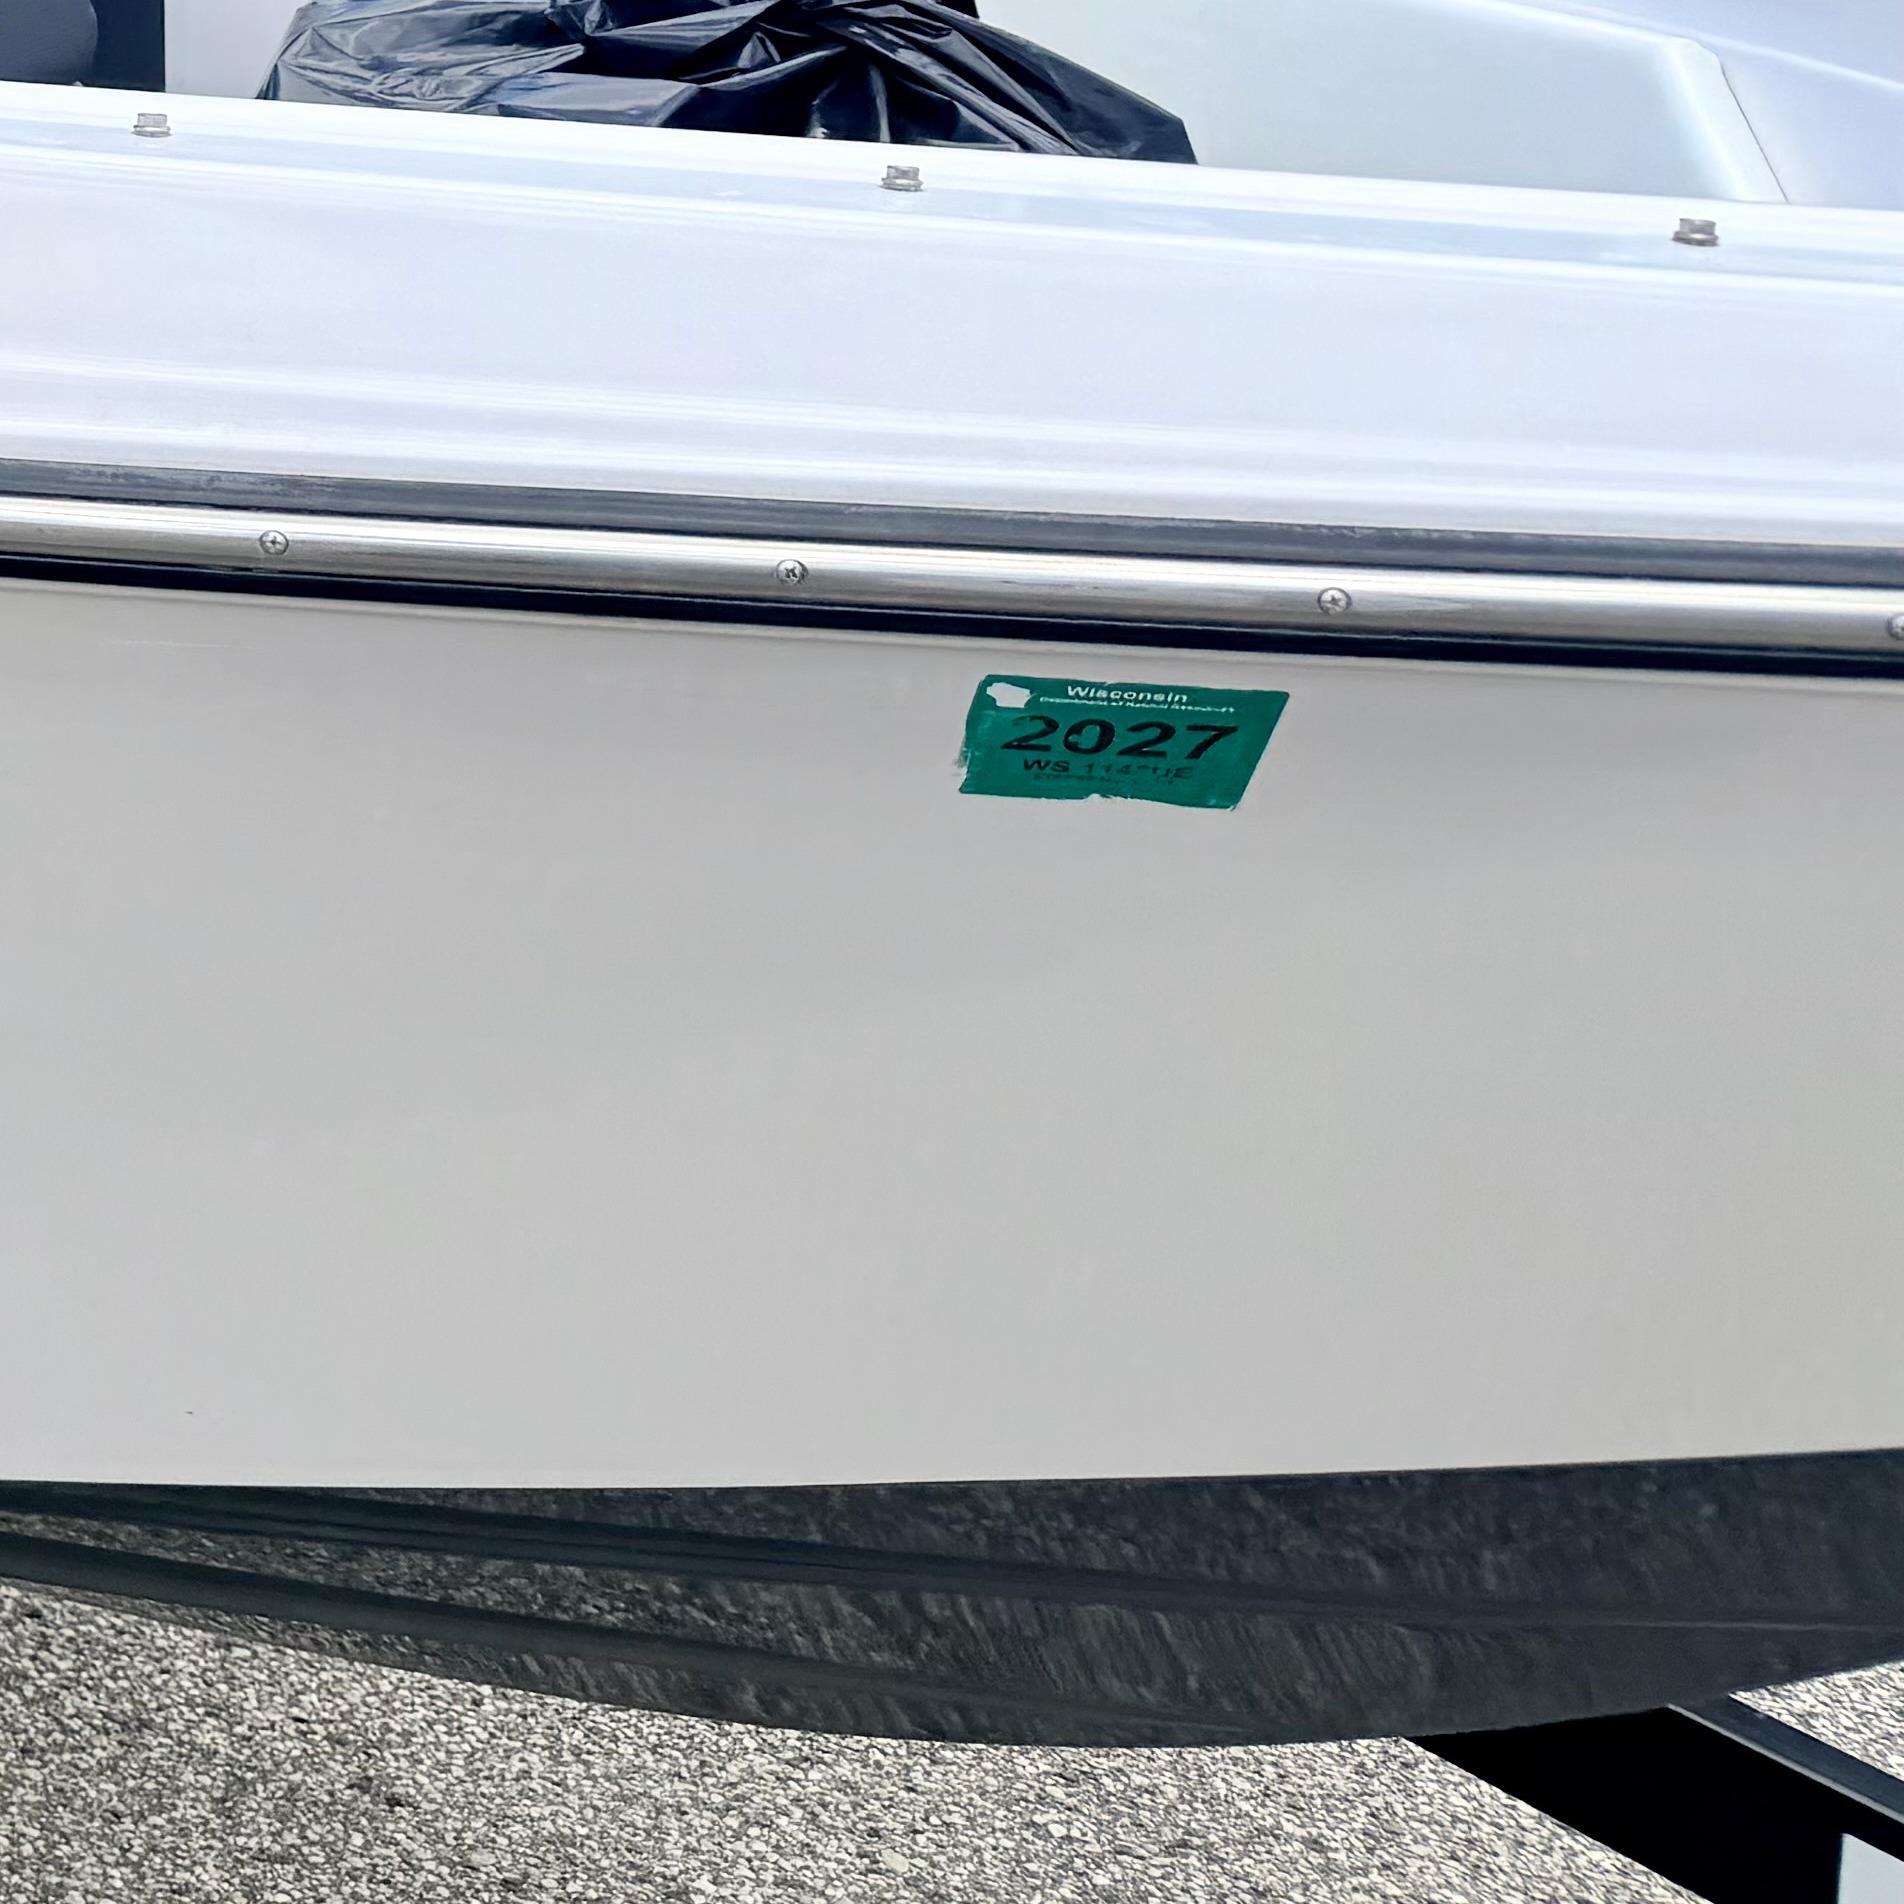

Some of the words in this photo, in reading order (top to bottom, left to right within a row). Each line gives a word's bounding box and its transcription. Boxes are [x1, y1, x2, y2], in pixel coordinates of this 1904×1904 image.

[1067, 685, 1188, 703] Wisconsin
[1001, 714, 1238, 760] 2027
[1023, 758, 1070, 773] WS
